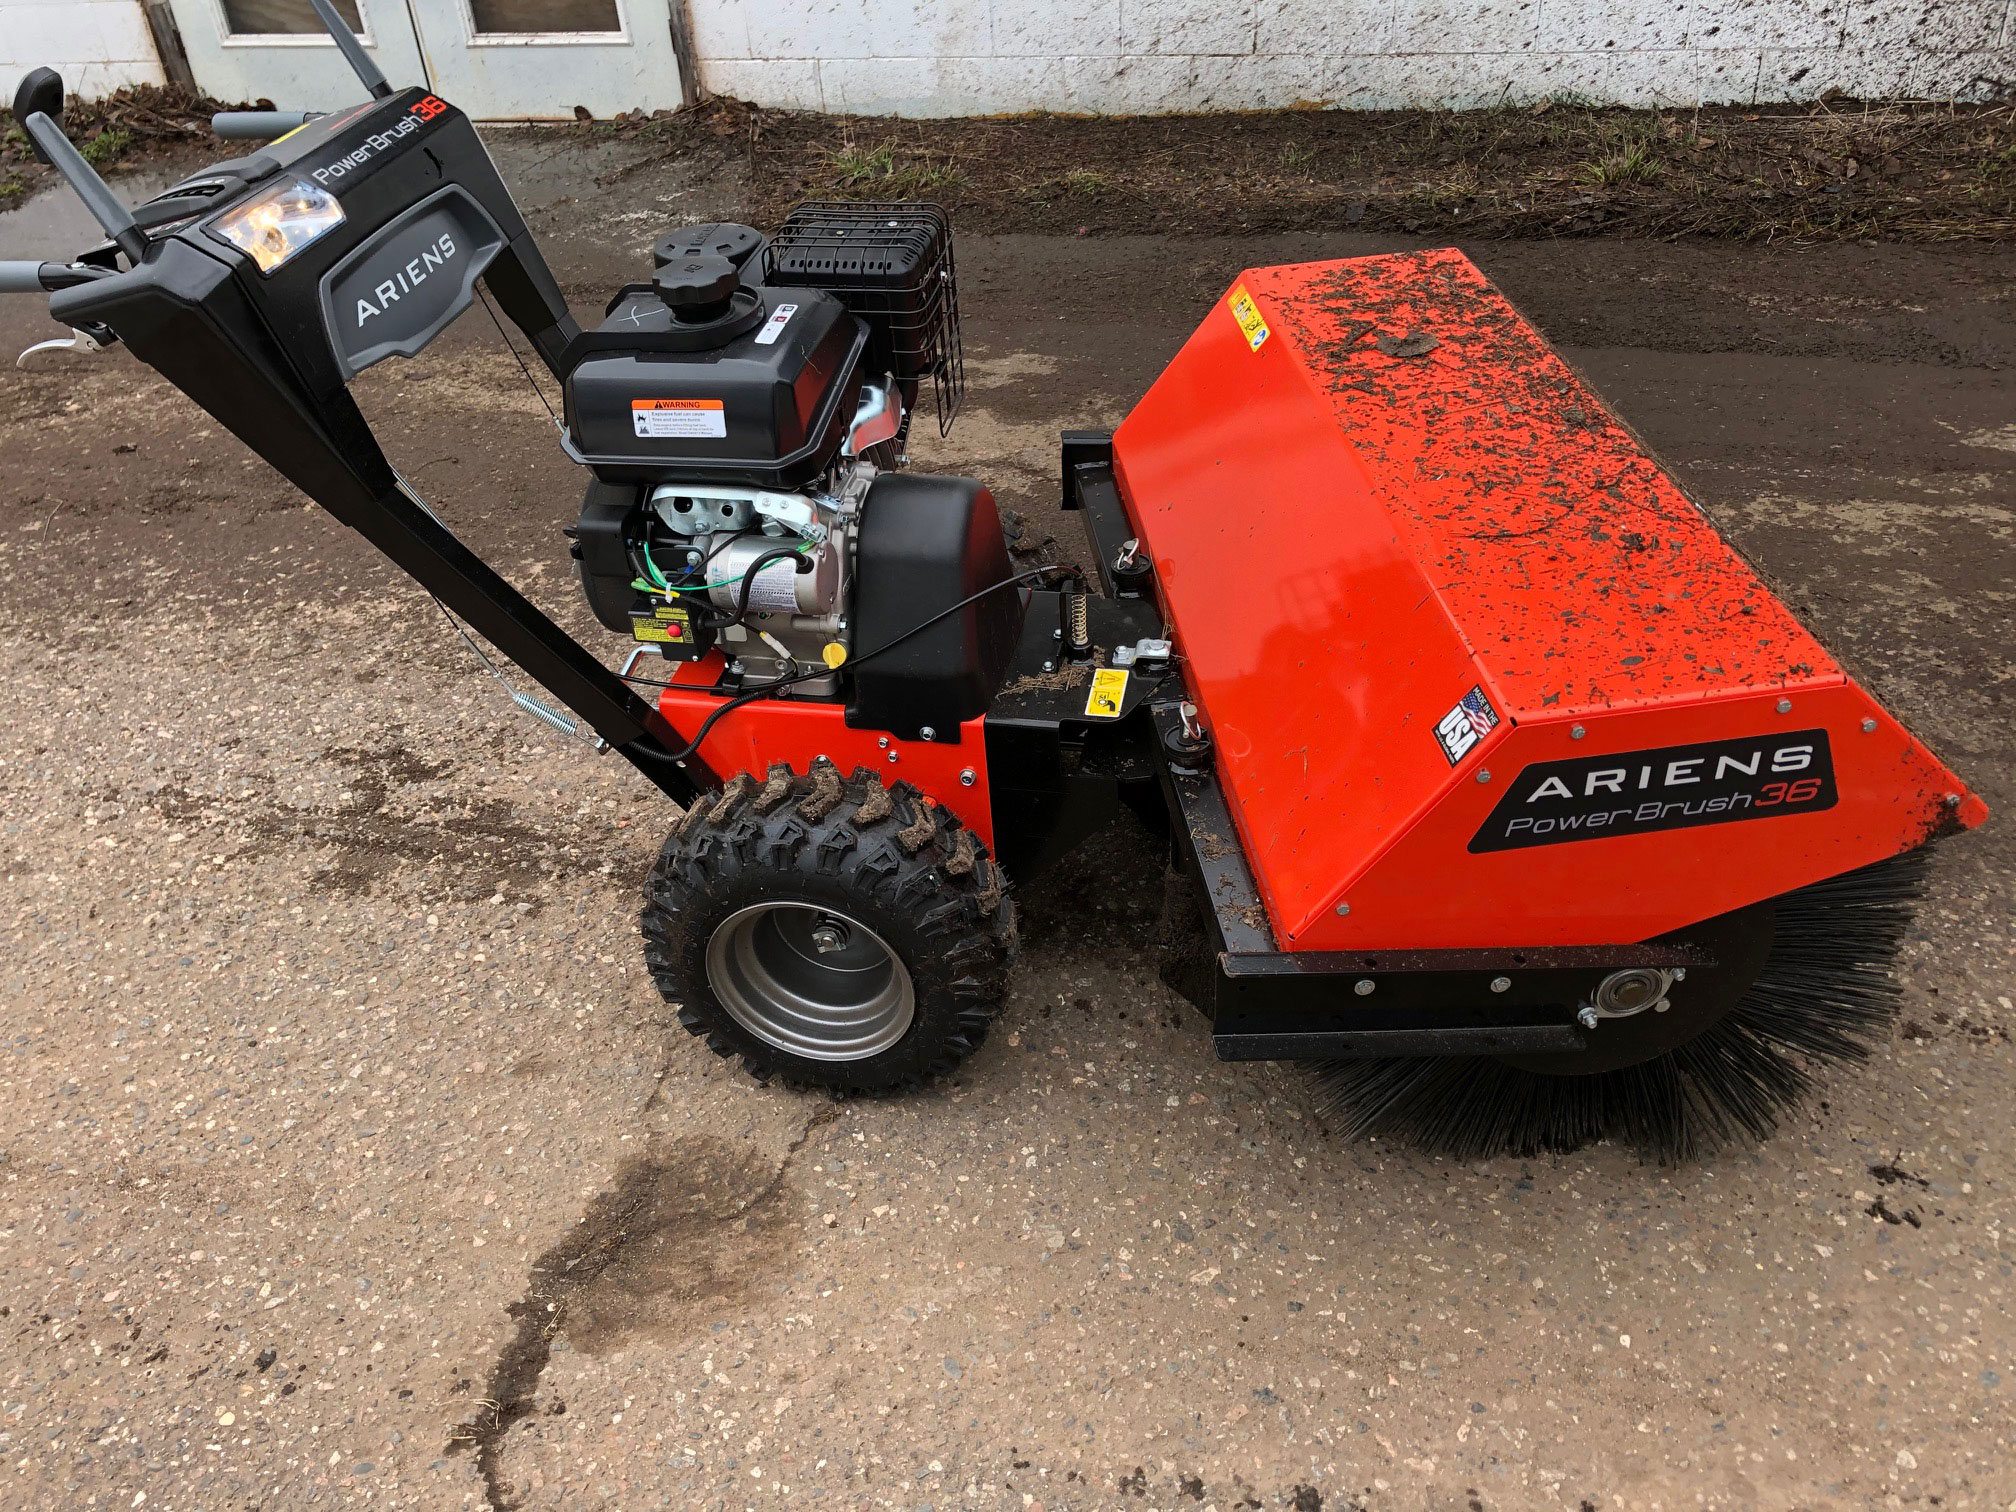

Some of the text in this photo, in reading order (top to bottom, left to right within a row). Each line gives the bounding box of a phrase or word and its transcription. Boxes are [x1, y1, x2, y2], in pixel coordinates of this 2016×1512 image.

[357, 233, 456, 328] ARIENS
[662, 401, 701, 409] WARNING
[1439, 705, 1478, 762] USA
[1473, 687, 1499, 726] MADE IN THE
[1526, 745, 1814, 803] ARIENS
